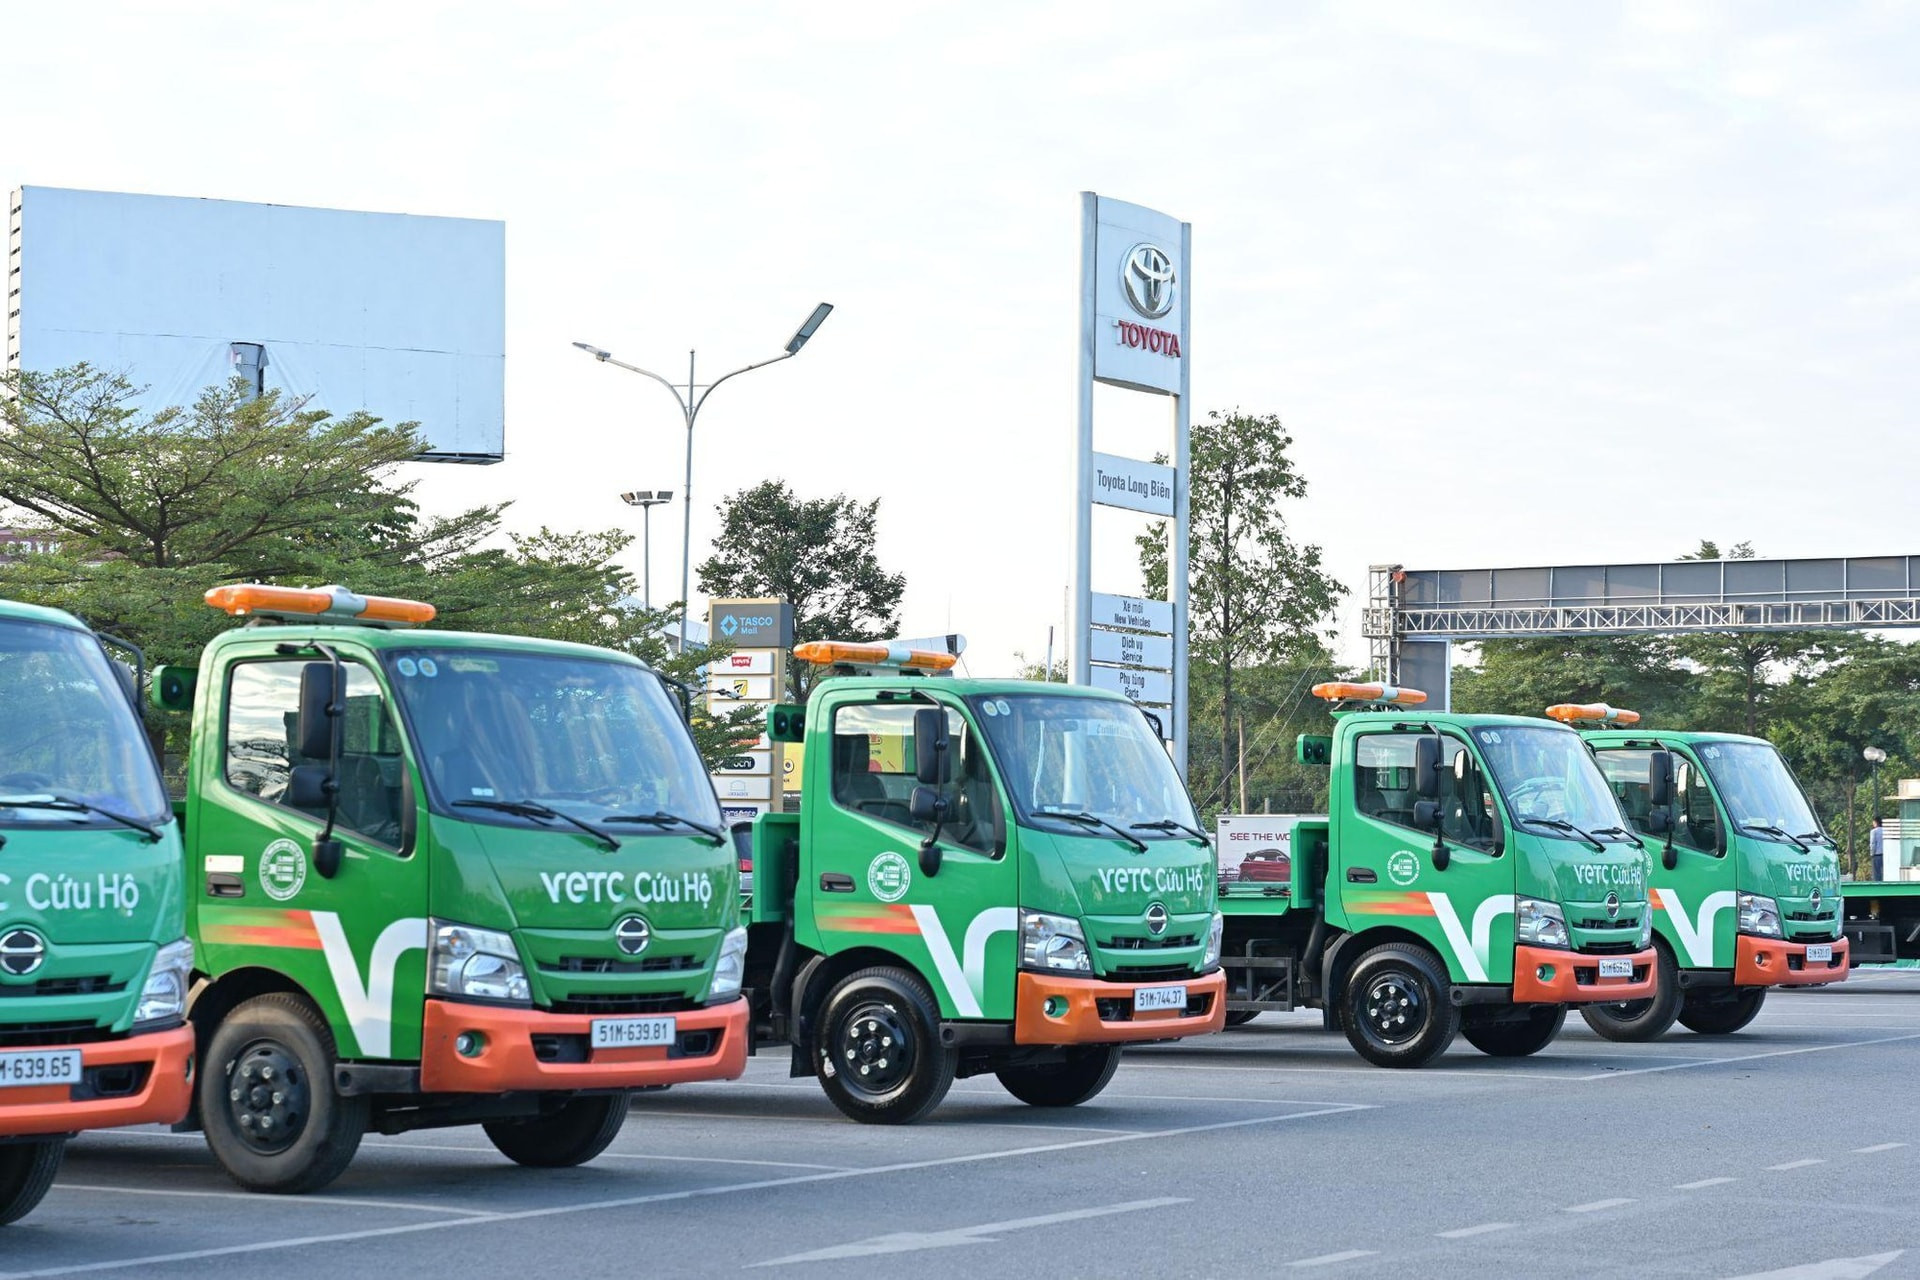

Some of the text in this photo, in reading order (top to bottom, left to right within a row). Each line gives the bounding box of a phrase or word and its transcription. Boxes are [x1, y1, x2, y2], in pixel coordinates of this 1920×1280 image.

[1118, 319, 1181, 358] TOYOTA
[1097, 469, 1170, 500] Toyota Long Biên
[1123, 600, 1131, 612] Xe
[739, 616, 773, 626] TASCO
[1115, 613, 1151, 628] New Vehicles
[741, 627, 758, 635] Mall
[1122, 636, 1136, 651] Dịch
[1122, 650, 1143, 663] Service
[1230, 832, 1249, 841] SEE
[1252, 832, 1273, 841] THE
[634, 871, 680, 903] Cứu
[683, 872, 712, 909] Hộ
[1155, 867, 1184, 893] Cứu
[1185, 867, 1203, 896] Hộ
[26, 872, 91, 911] Cứu
[98, 872, 139, 917] Hộ
[1140, 990, 1182, 1007] 51M-744.37
[600, 1023, 667, 1042] 51M-639.81
[0, 1056, 72, 1079] M-639.65
